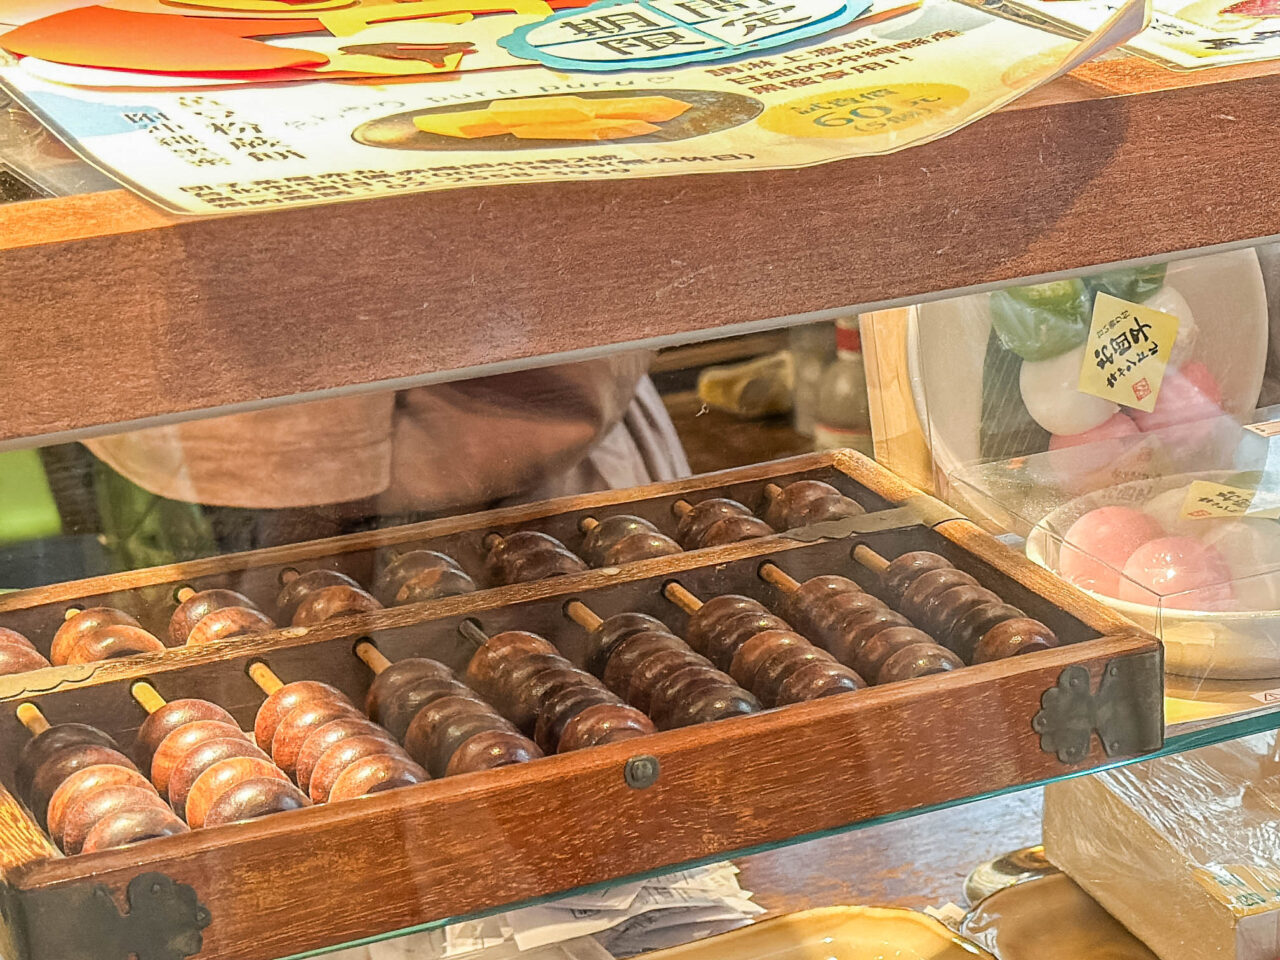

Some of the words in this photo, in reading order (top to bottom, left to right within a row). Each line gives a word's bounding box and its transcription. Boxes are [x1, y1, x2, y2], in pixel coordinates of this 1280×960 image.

[704, 38, 878, 77] 請淋上濃郁
[537, 79, 637, 95] puru
